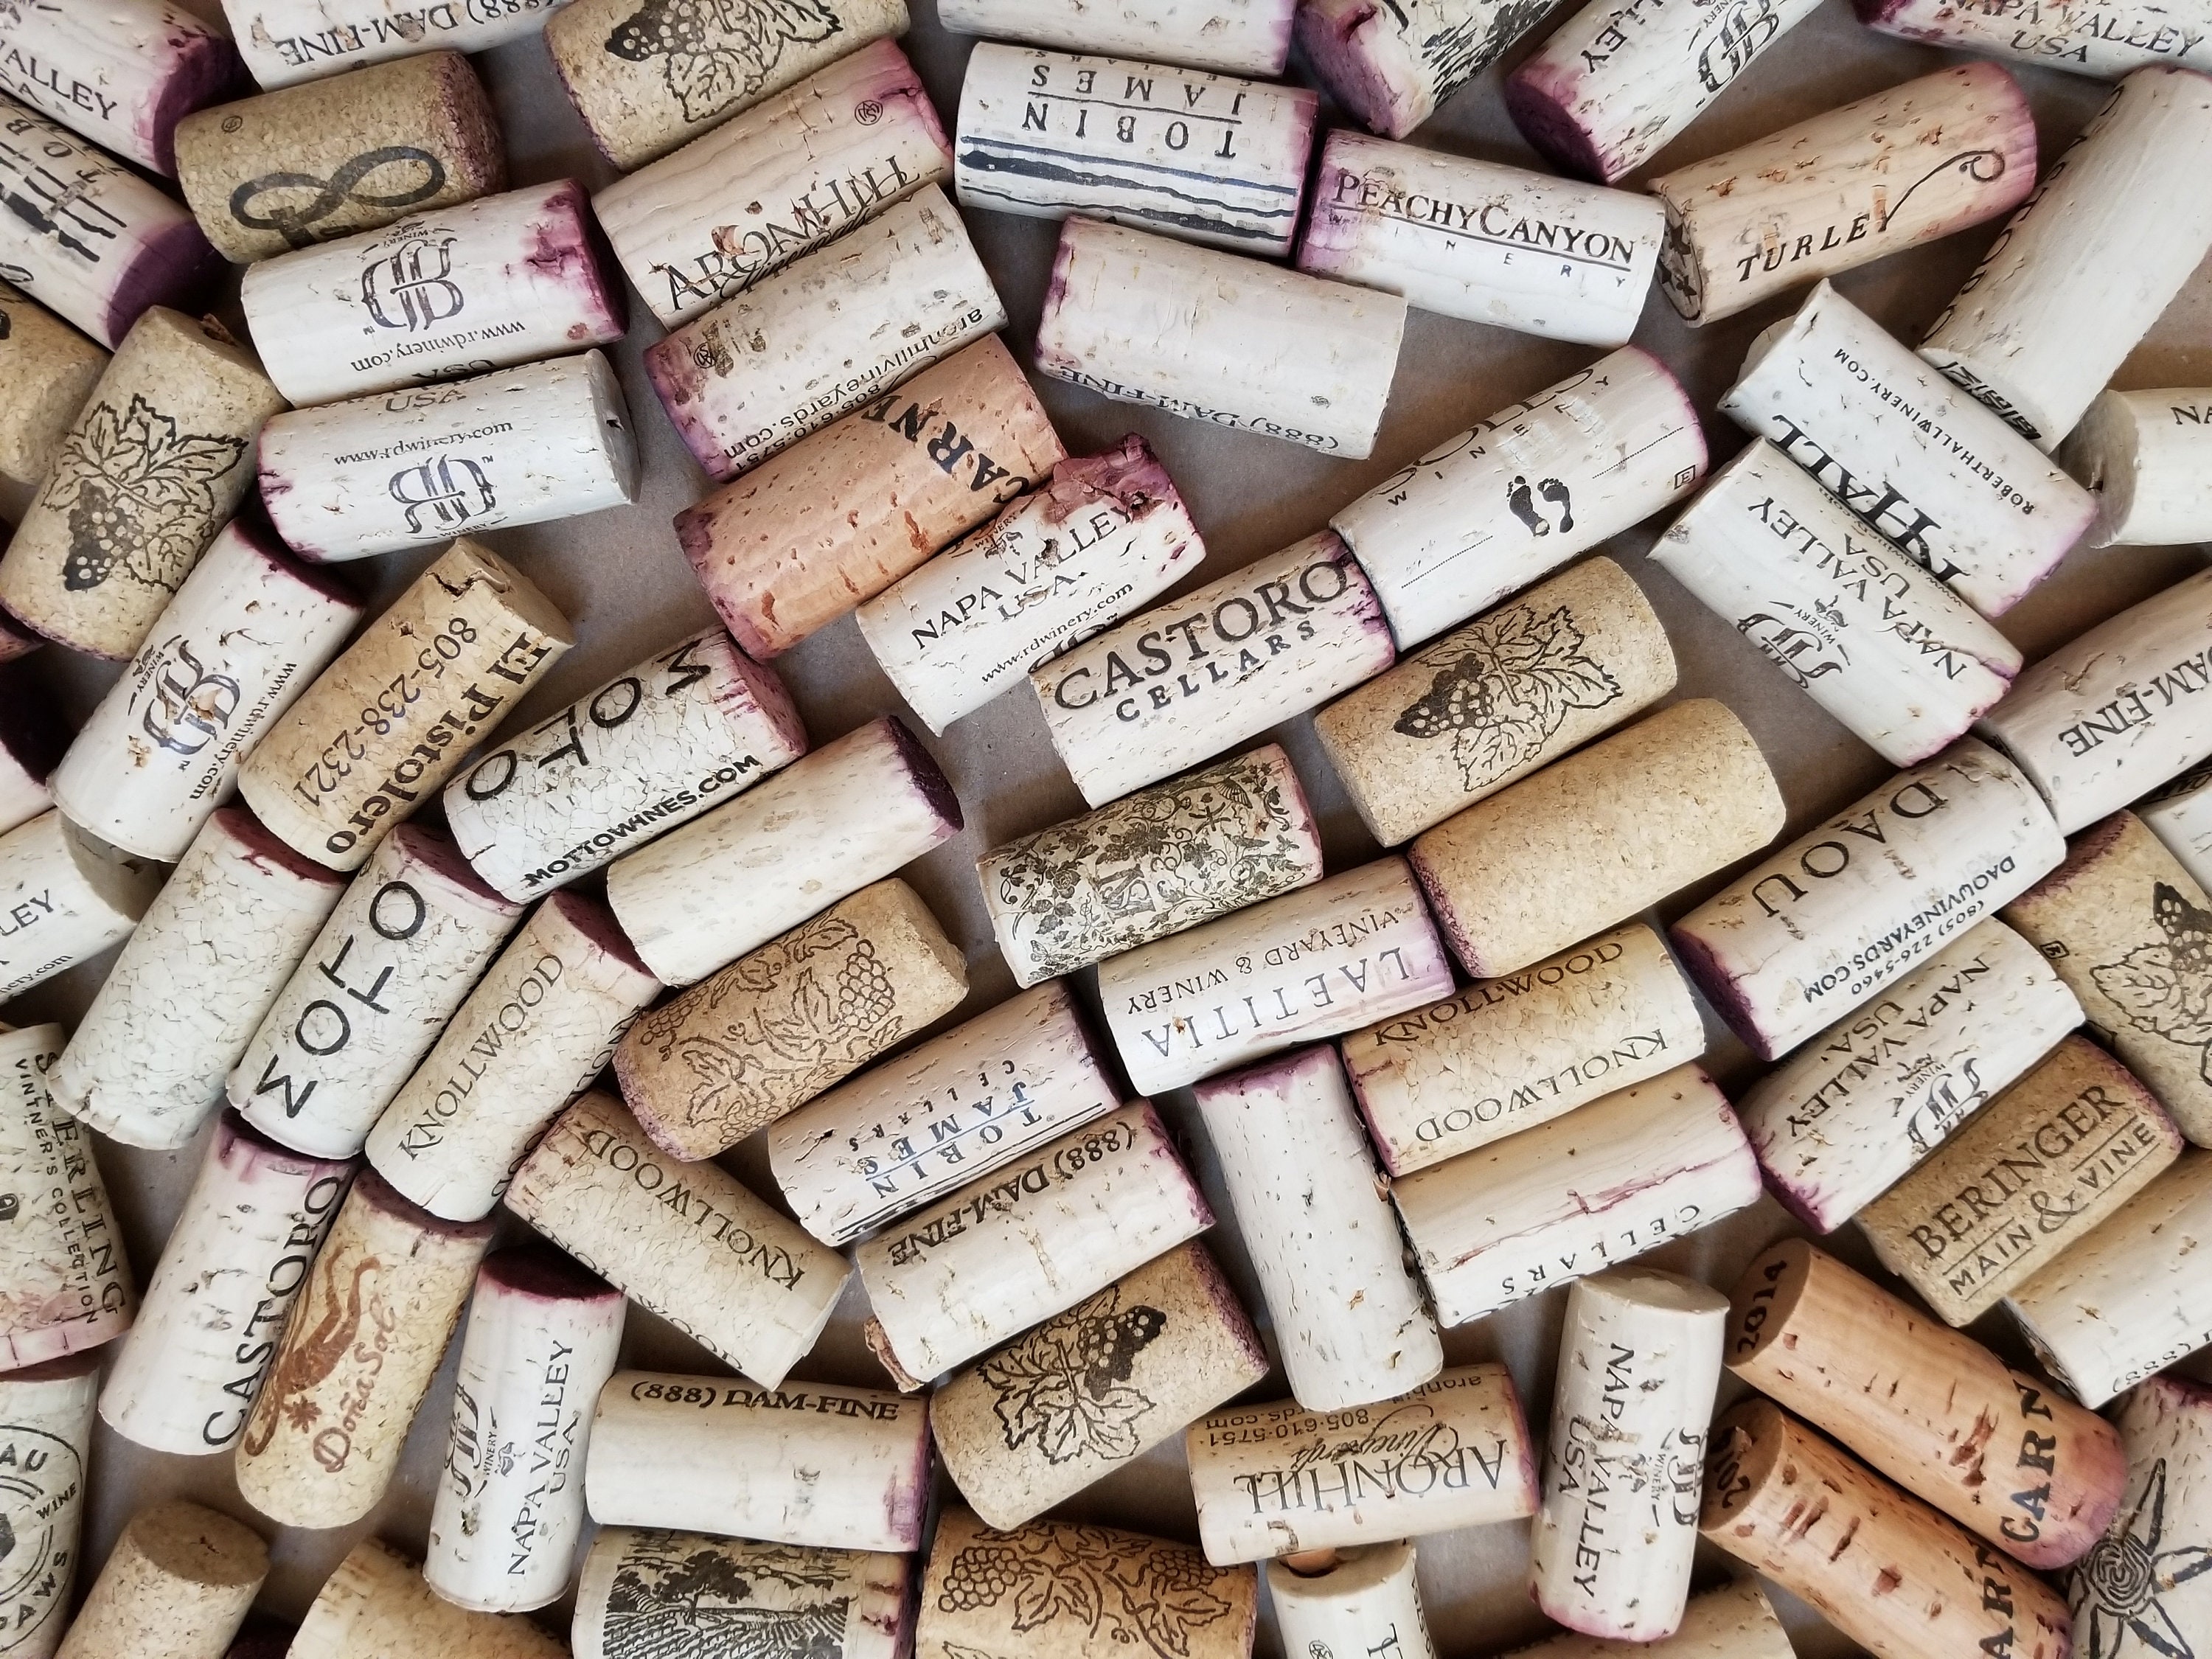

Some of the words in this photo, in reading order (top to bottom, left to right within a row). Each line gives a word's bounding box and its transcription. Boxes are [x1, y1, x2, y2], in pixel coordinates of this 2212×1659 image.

[0, 40, 117, 120] ALLEY
[278, 3, 459, 68] DAM-FINE
[2011, 30, 2087, 62] USA
[1022, 101, 1237, 159] TOBIN
[1032, 65, 1246, 115] JAMES
[350, 321, 526, 372] www.rdwinery.com
[386, 389, 467, 412] USA
[1747, 496, 1867, 602] VALLEY
[1843, 533, 1910, 599] USA
[911, 585, 1003, 650] NAPA
[981, 582, 1133, 683] www.rdwinery.com
[1054, 560, 1349, 710] CASTORO
[1794, 608, 1836, 645] WINERY
[1881, 596, 1967, 680] NAPA
[293, 617, 477, 807] 805-238-2321
[1116, 620, 1315, 722] CELLARS
[2058, 646, 2212, 757] AM-FINE
[465, 637, 711, 801] MOTTO
[326, 683, 504, 853] Pistolero
[1752, 783, 1949, 918] DAOU
[1236, 956, 1252, 974] &
[1265, 911, 1399, 965] VINEYARD
[1851, 933, 1933, 995] 226-5460
[1938, 900, 1984, 937] (805)
[256, 880, 425, 1119] MOTTO
[1128, 968, 1228, 1015] WINERY
[1141, 947, 1411, 1057] LAETITIA
[1374, 942, 1623, 1046] KNOLLWOOD
[1826, 1000, 1905, 1052] USA
[1903, 956, 1989, 1028] NAPA
[398, 954, 563, 1161] KNOLLWOOD
[1415, 1028, 1668, 1142] KNOLLWOOD
[1786, 1037, 1907, 1137] VALLEY
[849, 1060, 1016, 1151] CELLARS
[859, 1081, 1027, 1176] JAMES
[872, 1105, 1043, 1199] TOBIN
[1053, 1121, 1136, 1180] (888)
[15, 1059, 58, 1176] VINTNER'S
[52, 1187, 98, 1324] COLLECTION
[35, 1051, 125, 1314] SERLING
[582, 1130, 805, 1291] KNOLLWOOD
[888, 1163, 1050, 1266] DAM-FINE
[1907, 1085, 2126, 1259] BERINGER
[1949, 1224, 2032, 1295] MAIN
[2030, 1190, 2090, 1234] &
[2078, 1122, 2156, 1189] VINE
[1501, 1204, 1700, 1295] CELLARS
[203, 1176, 340, 1445] CASTORO
[1737, 1260, 1787, 1354] 2014
[630, 1381, 717, 1408] (888)
[723, 1390, 900, 1421] DAM-FINE
[507, 1484, 546, 1576] NAPA
[530, 1340, 573, 1473] VALLEY
[549, 1417, 579, 1495] USA
[1558, 1414, 1587, 1493] USA
[36, 1482, 76, 1520] WINE
[1573, 1456, 1616, 1598] VALLEY
